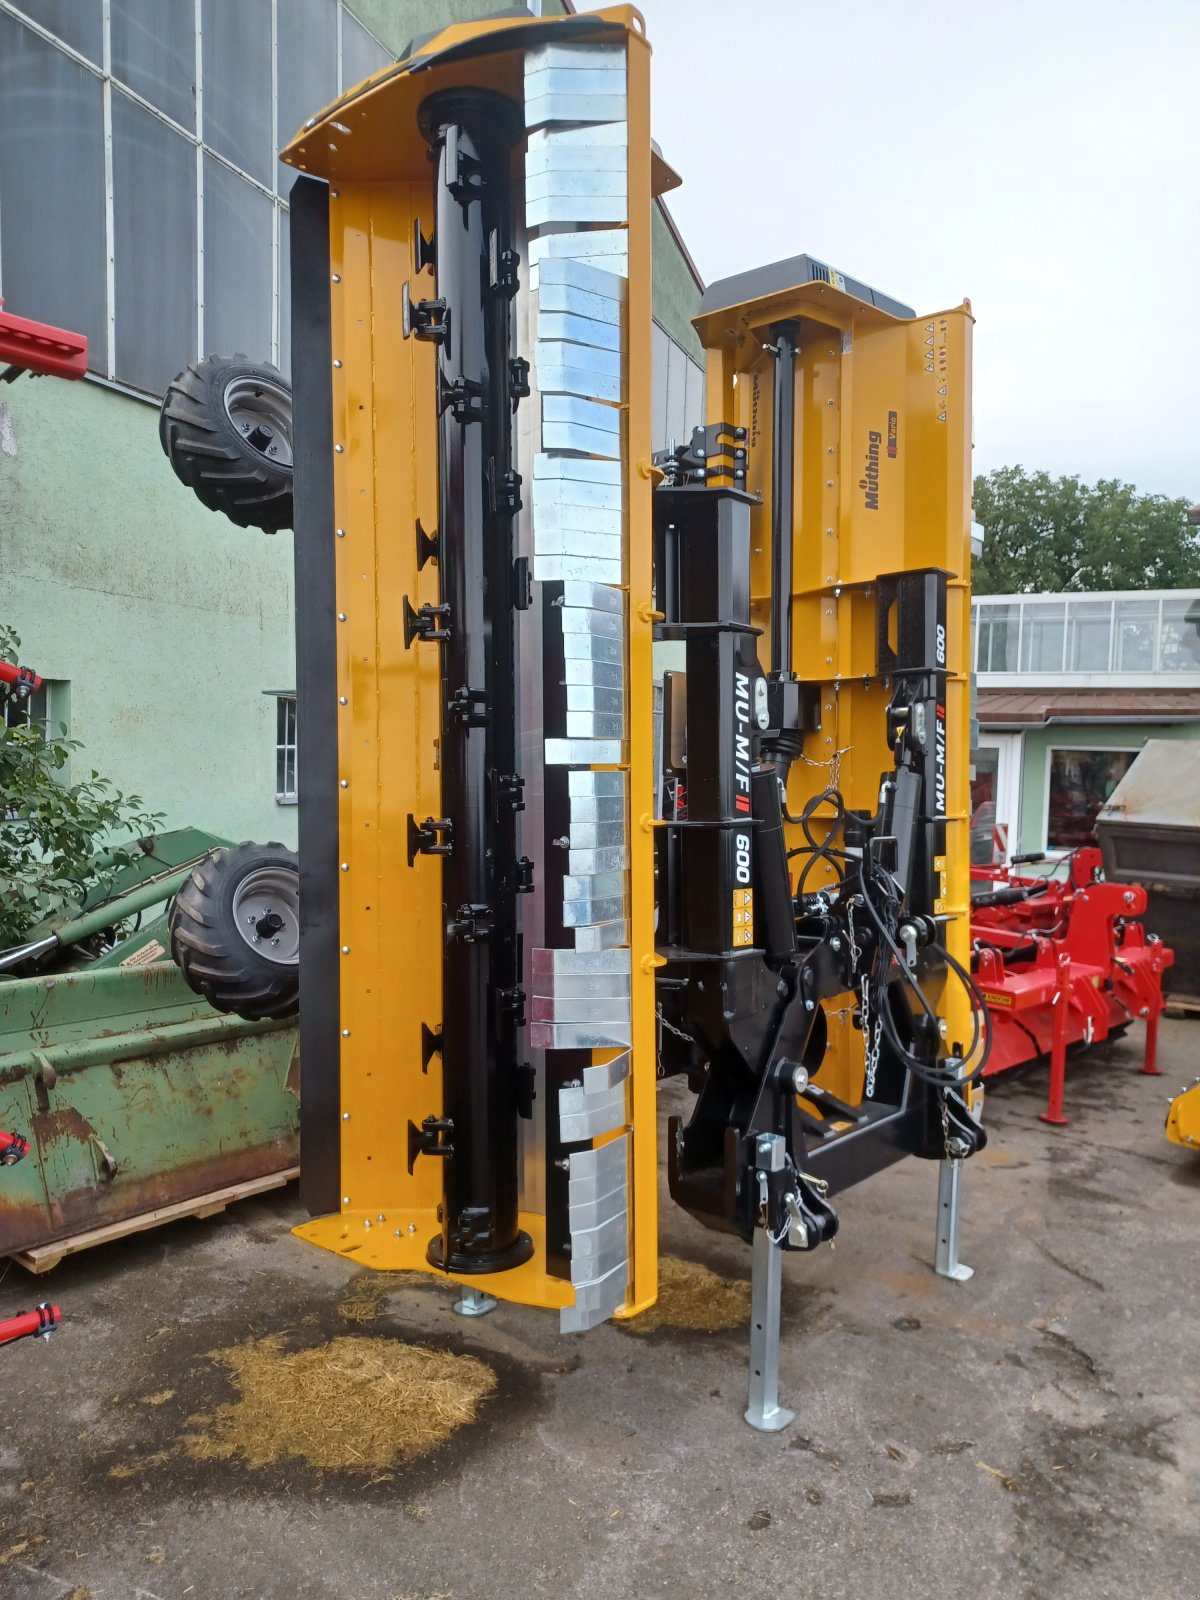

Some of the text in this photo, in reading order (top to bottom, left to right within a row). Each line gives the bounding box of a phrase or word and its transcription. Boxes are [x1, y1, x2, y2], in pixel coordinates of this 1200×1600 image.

[889, 417, 897, 439] Vario
[859, 430, 881, 510] Müthing
[936, 623, 945, 664] 600
[736, 834, 750, 884] 600
